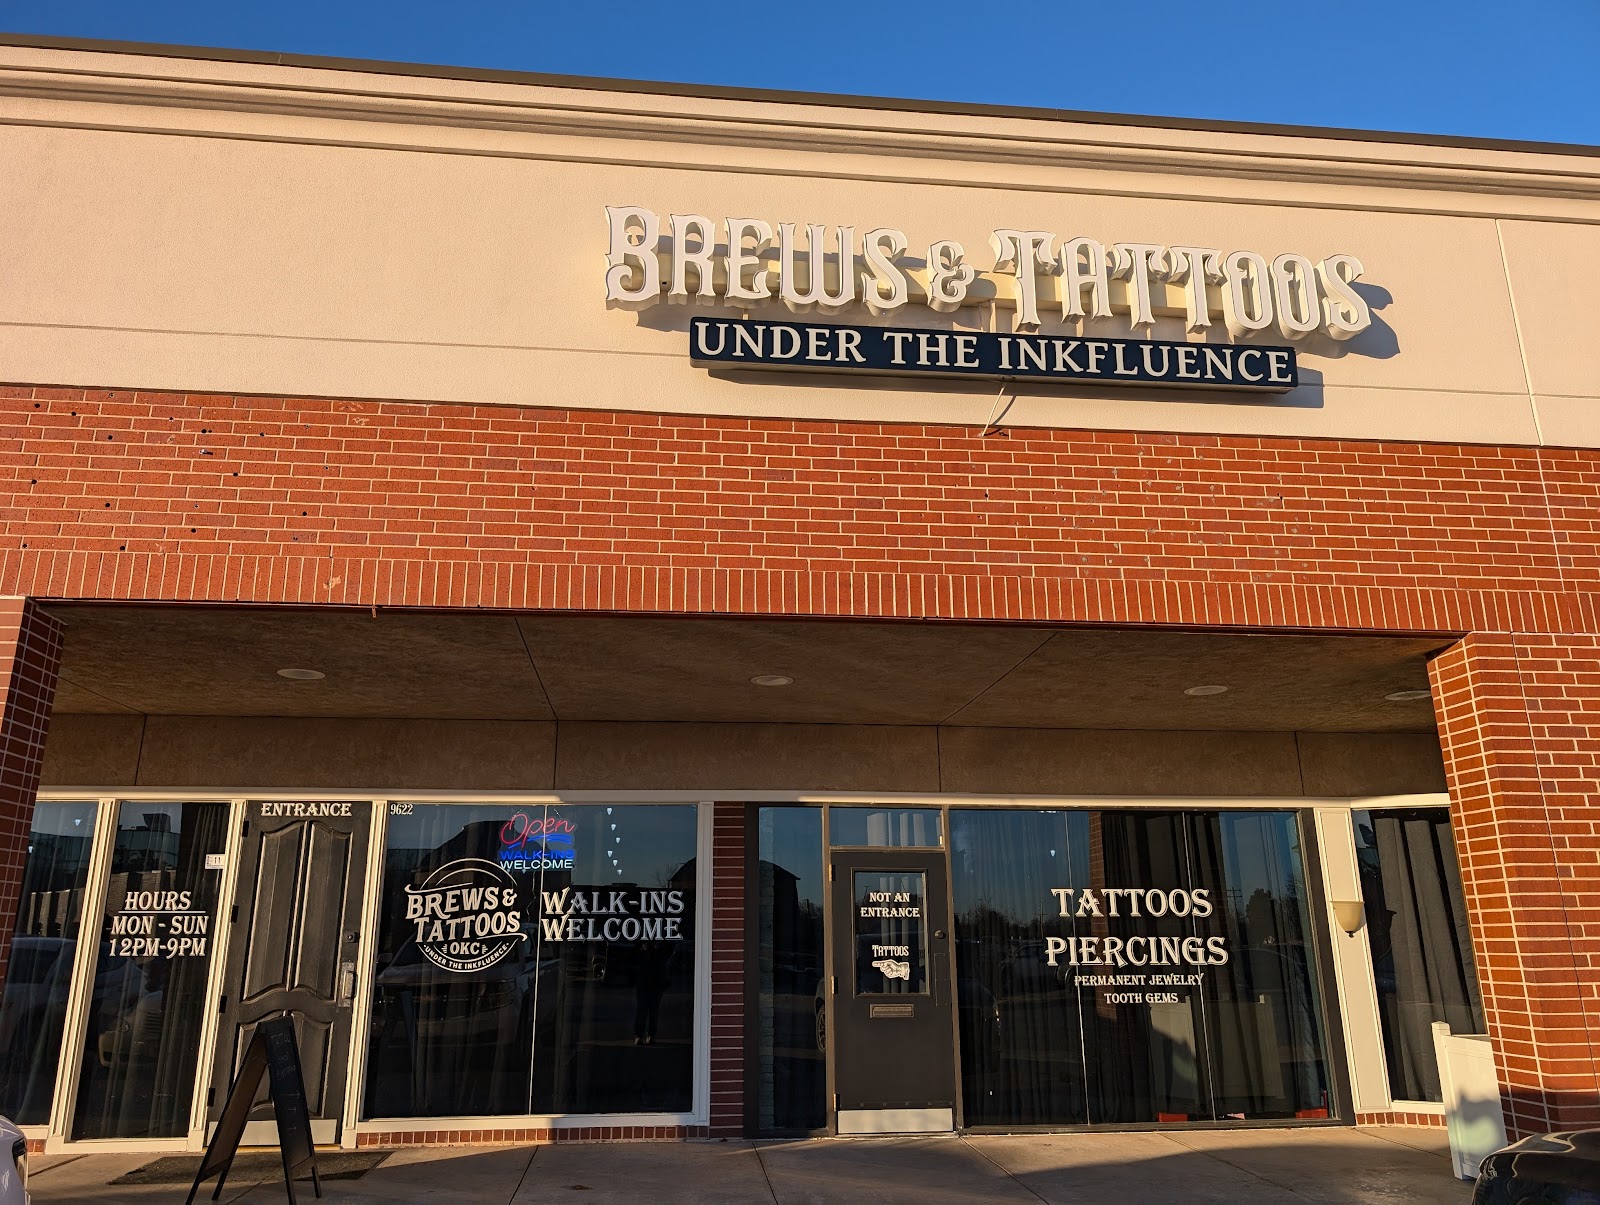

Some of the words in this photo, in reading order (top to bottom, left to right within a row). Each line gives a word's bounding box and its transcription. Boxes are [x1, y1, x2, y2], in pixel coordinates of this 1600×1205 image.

[604, 205, 909, 311] BREWS
[926, 238, 976, 307] &
[988, 228, 1372, 336] TATTOOS
[694, 321, 867, 363] UNDER
[882, 331, 981, 369] THE
[997, 337, 1293, 384] INKFLUENCE
[260, 802, 353, 817] ENTRANCE
[389, 803, 414, 816] 9622
[500, 813, 575, 848] Open
[500, 849, 575, 861] WALK-INS
[500, 859, 574, 871] WELCOME
[124, 890, 192, 911] HOURS
[405, 886, 500, 919] BREWS
[502, 888, 518, 908] &
[541, 887, 685, 915] WALK-INS
[869, 892, 892, 903] NOT
[893, 892, 911, 903] AN
[1051, 888, 1214, 918] TATTOOS
[860, 907, 921, 918] ENTRANCE
[111, 915, 153, 936] MON
[171, 915, 209, 935] SUN
[413, 911, 522, 943] TATTOOS
[541, 914, 684, 942] WELCOME
[109, 938, 207, 959] 12PM-9PM
[425, 946, 447, 965] UNDER
[449, 961, 463, 970] THE
[464, 944, 508, 970] INKFLUENCE
[449, 942, 480, 955] OKC
[871, 944, 910, 958] TATTOOS
[1044, 936, 1229, 968] PIERCINGS
[1074, 974, 1147, 987] PERMANENT
[1149, 972, 1205, 987] JEWELRY
[1103, 992, 1143, 1004] TOOTH
[1145, 992, 1179, 1004] GEMS
